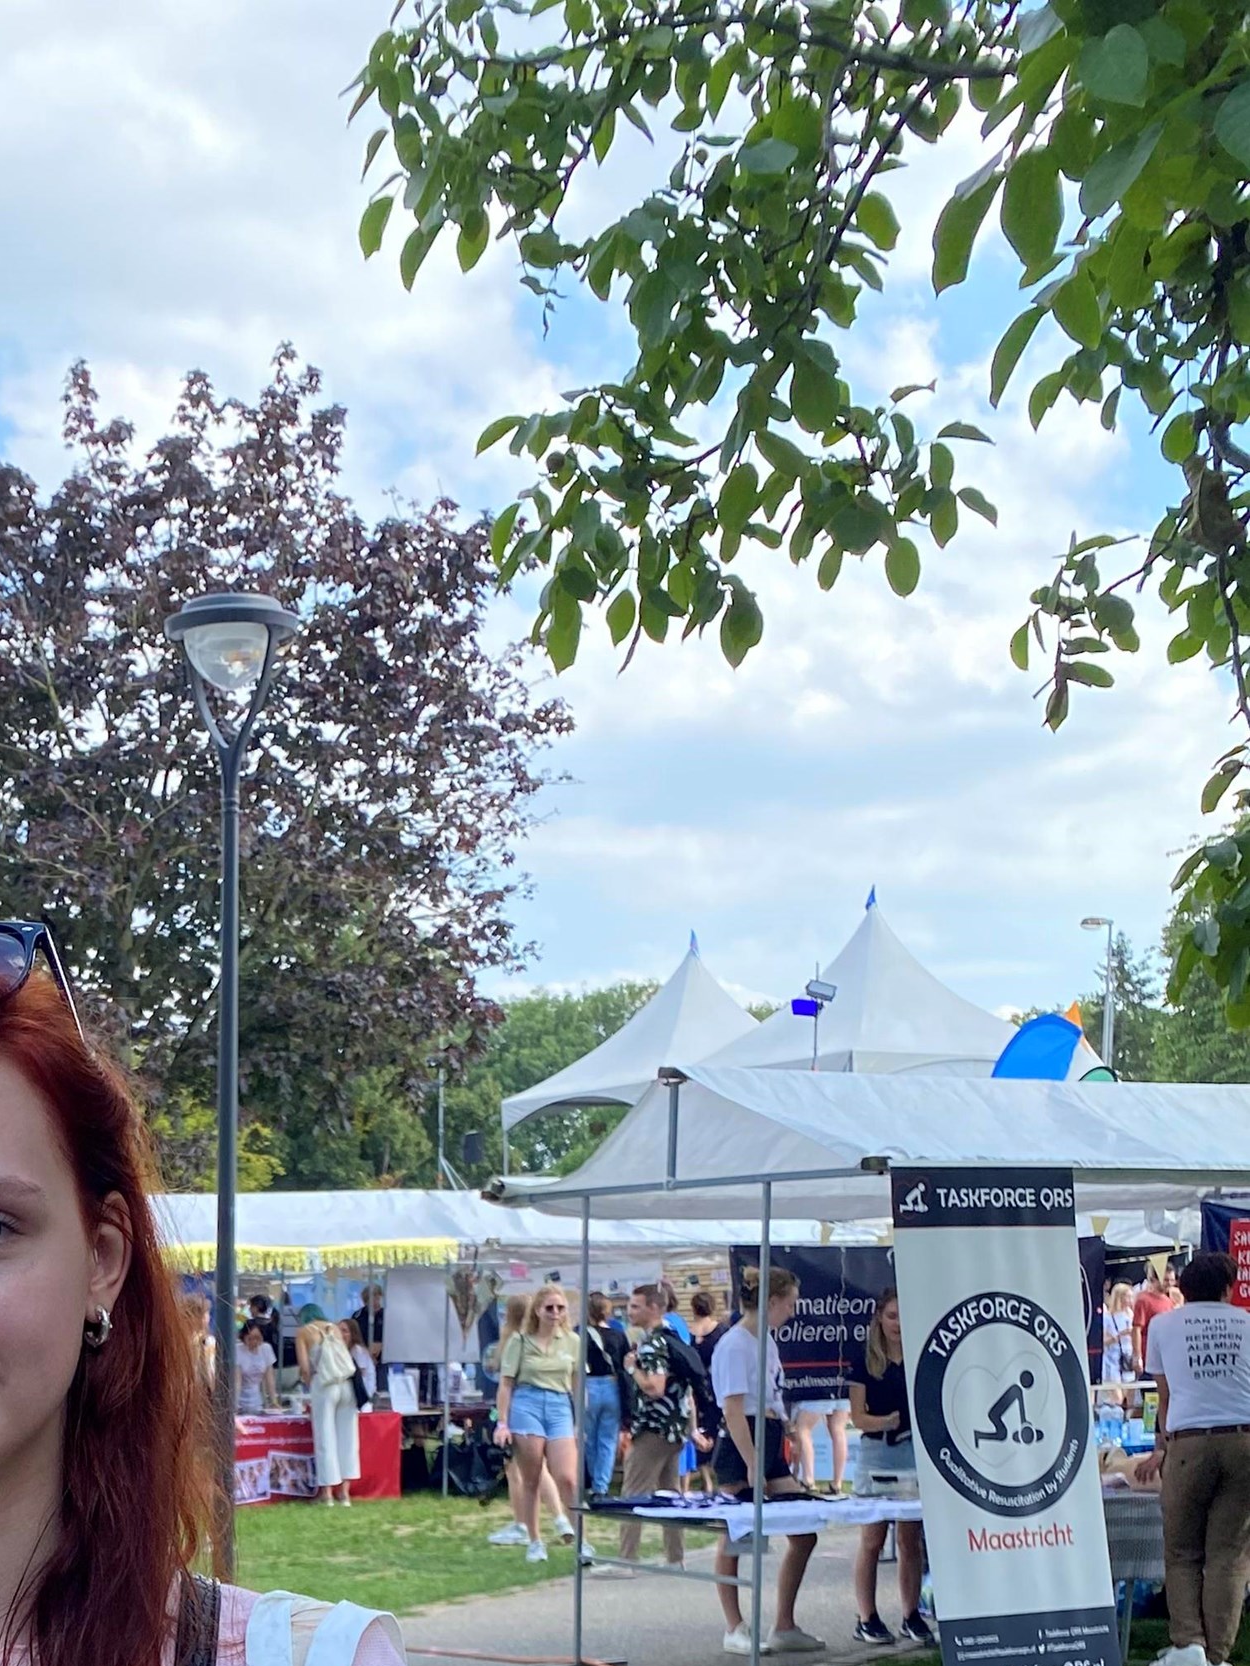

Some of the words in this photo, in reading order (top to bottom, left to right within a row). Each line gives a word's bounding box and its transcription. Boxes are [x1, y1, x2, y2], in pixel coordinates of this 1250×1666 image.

[936, 1187, 1037, 1208] TASKFORCE
[1039, 1187, 1073, 1211] QRS
[795, 1293, 877, 1316] matieon
[928, 1297, 1032, 1358] TASKFORCE
[1033, 1315, 1068, 1357] QRS
[1188, 1353, 1239, 1369] HART
[1045, 1480, 1059, 1495] by
[967, 1522, 1075, 1552] Maastricht
